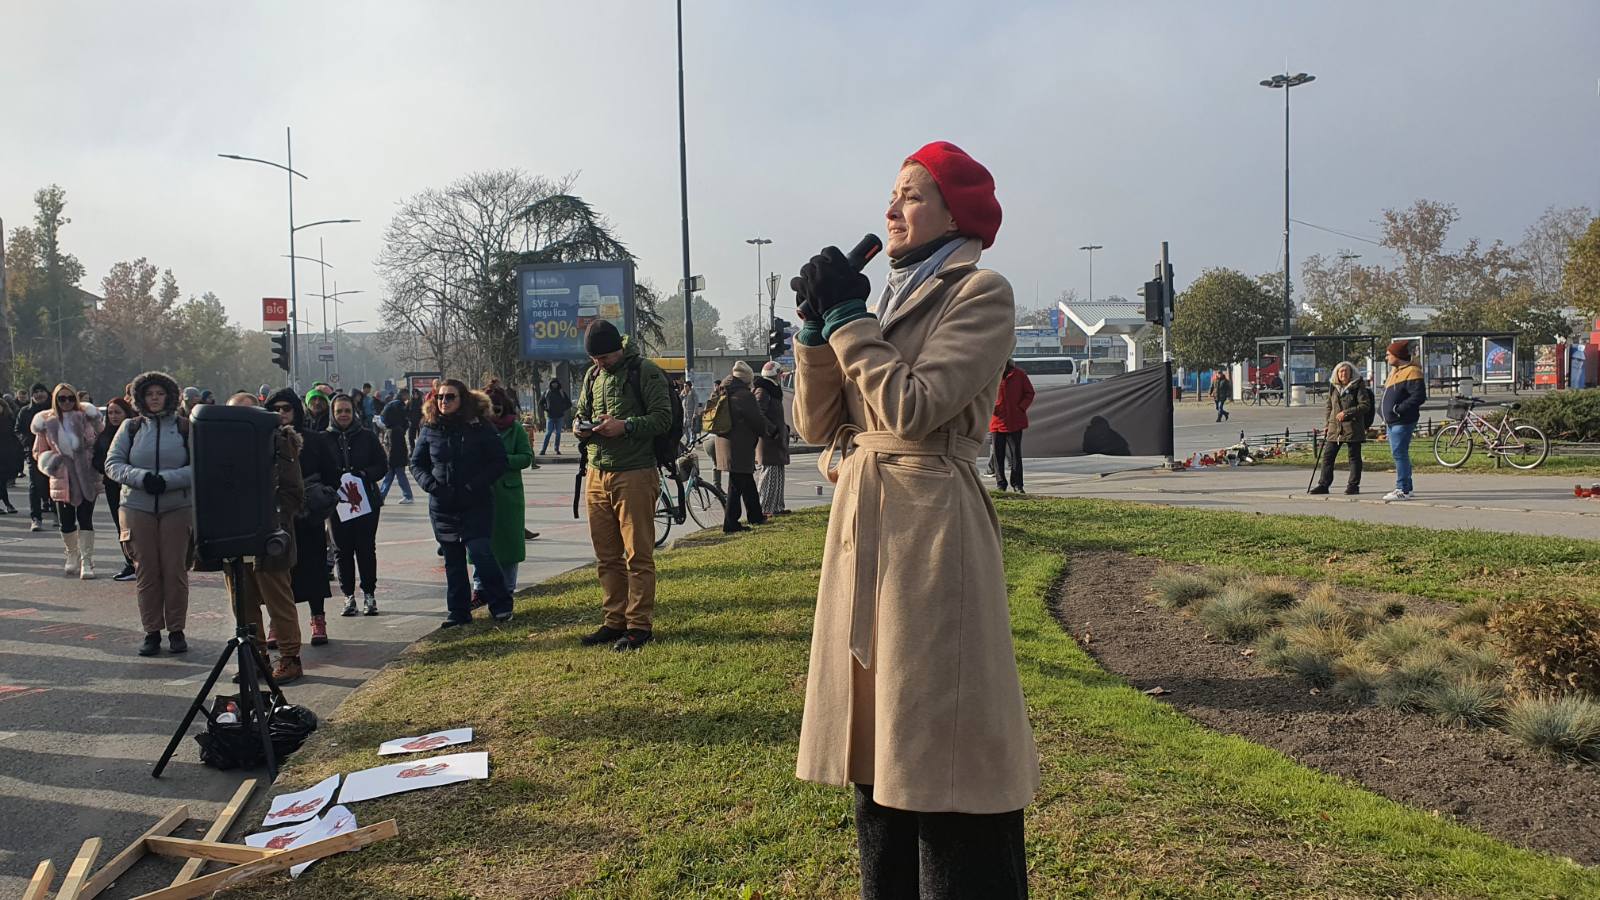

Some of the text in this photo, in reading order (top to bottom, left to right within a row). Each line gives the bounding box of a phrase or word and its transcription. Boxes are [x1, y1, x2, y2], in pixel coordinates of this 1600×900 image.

[532, 299, 559, 308] SVE za
[532, 308, 567, 320] negu lica
